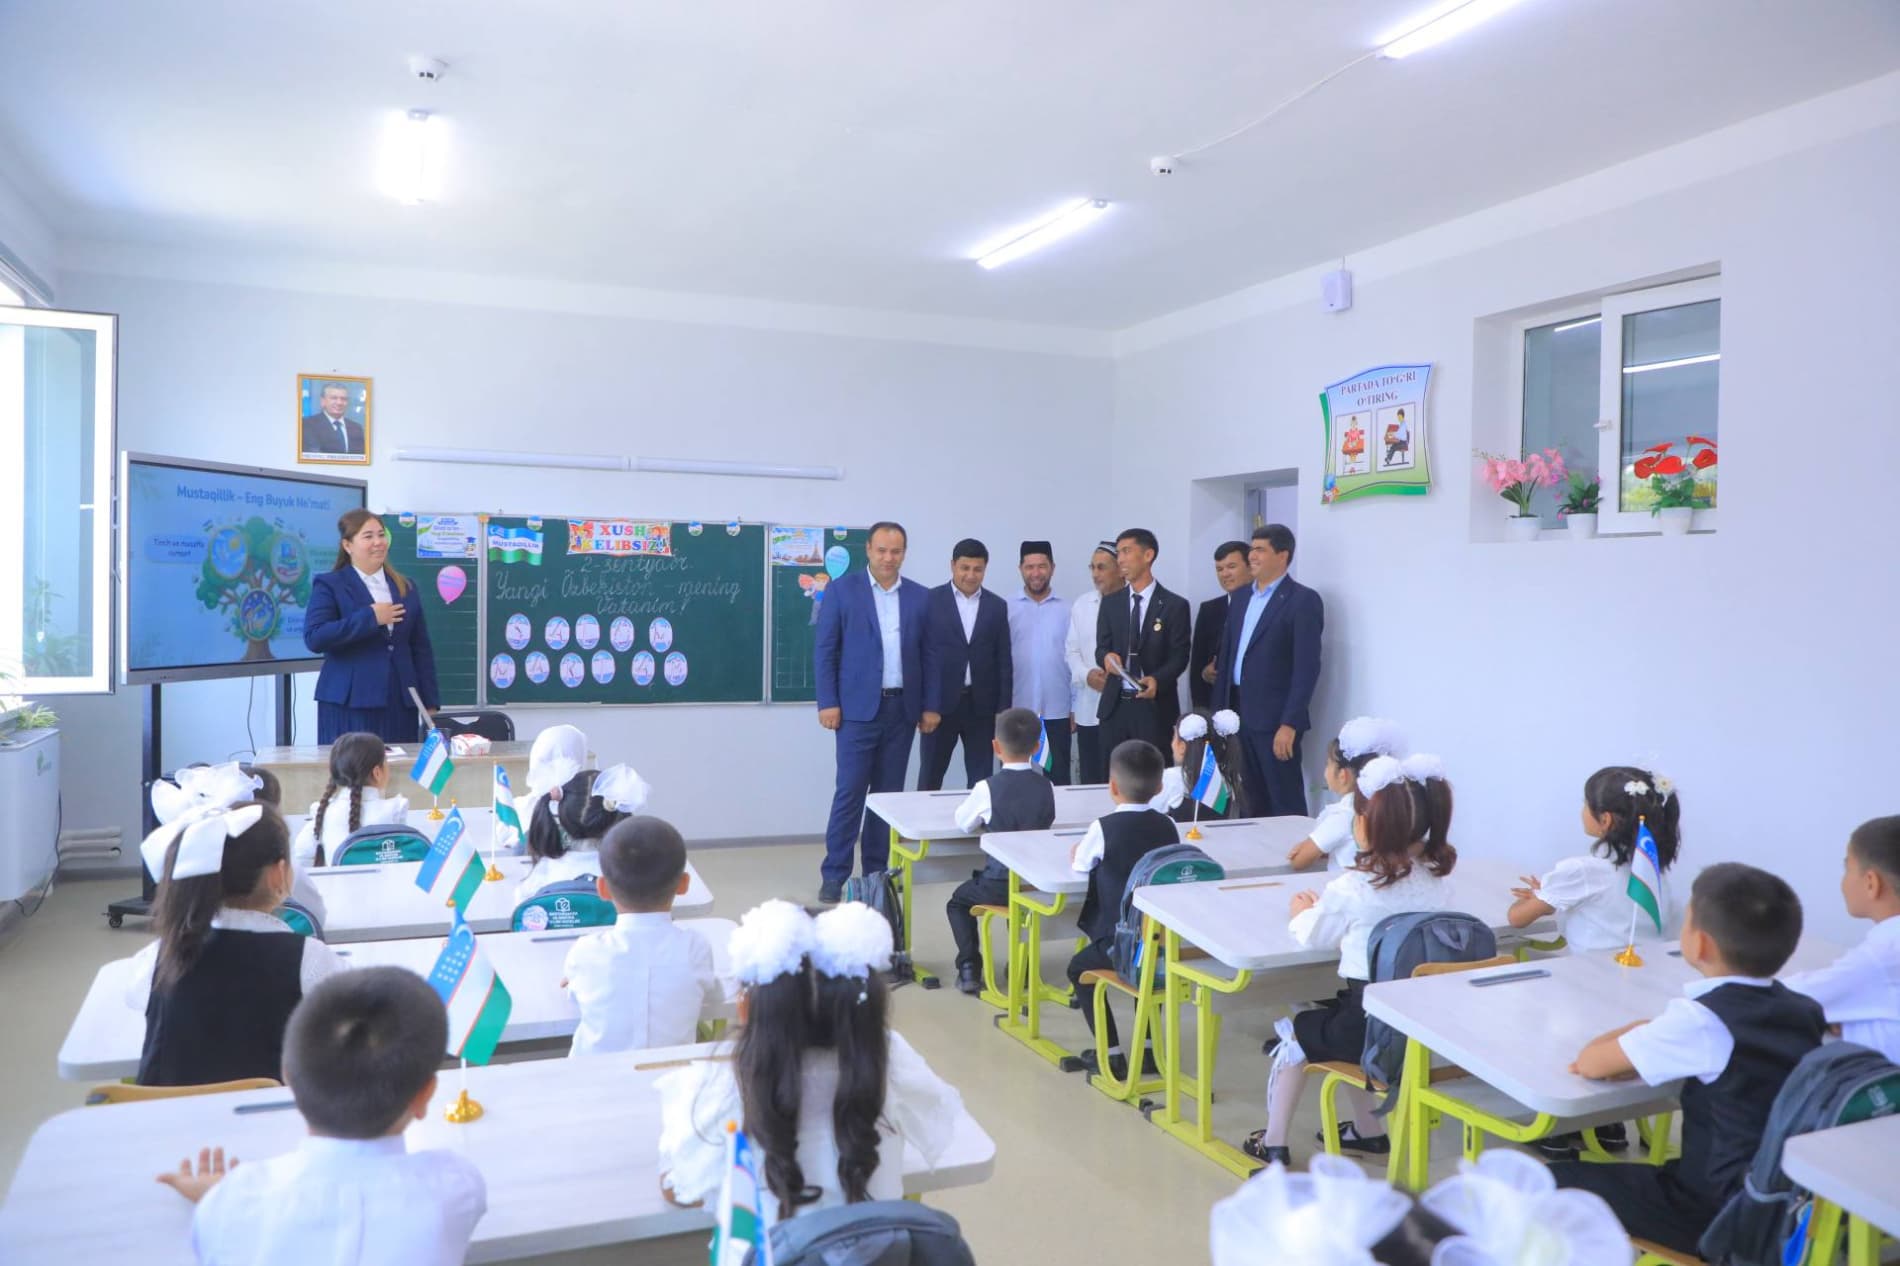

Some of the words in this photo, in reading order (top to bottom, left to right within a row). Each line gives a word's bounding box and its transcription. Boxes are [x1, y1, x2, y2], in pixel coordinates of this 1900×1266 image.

[1341, 380, 1380, 396] PARTADA
[176, 485, 235, 502] Mustaqillik
[245, 492, 264, 507] Eng
[266, 494, 295, 508] Buyuk
[600, 525, 647, 537] XUSH
[495, 569, 549, 608] Yangi
[678, 576, 742, 604] mening
